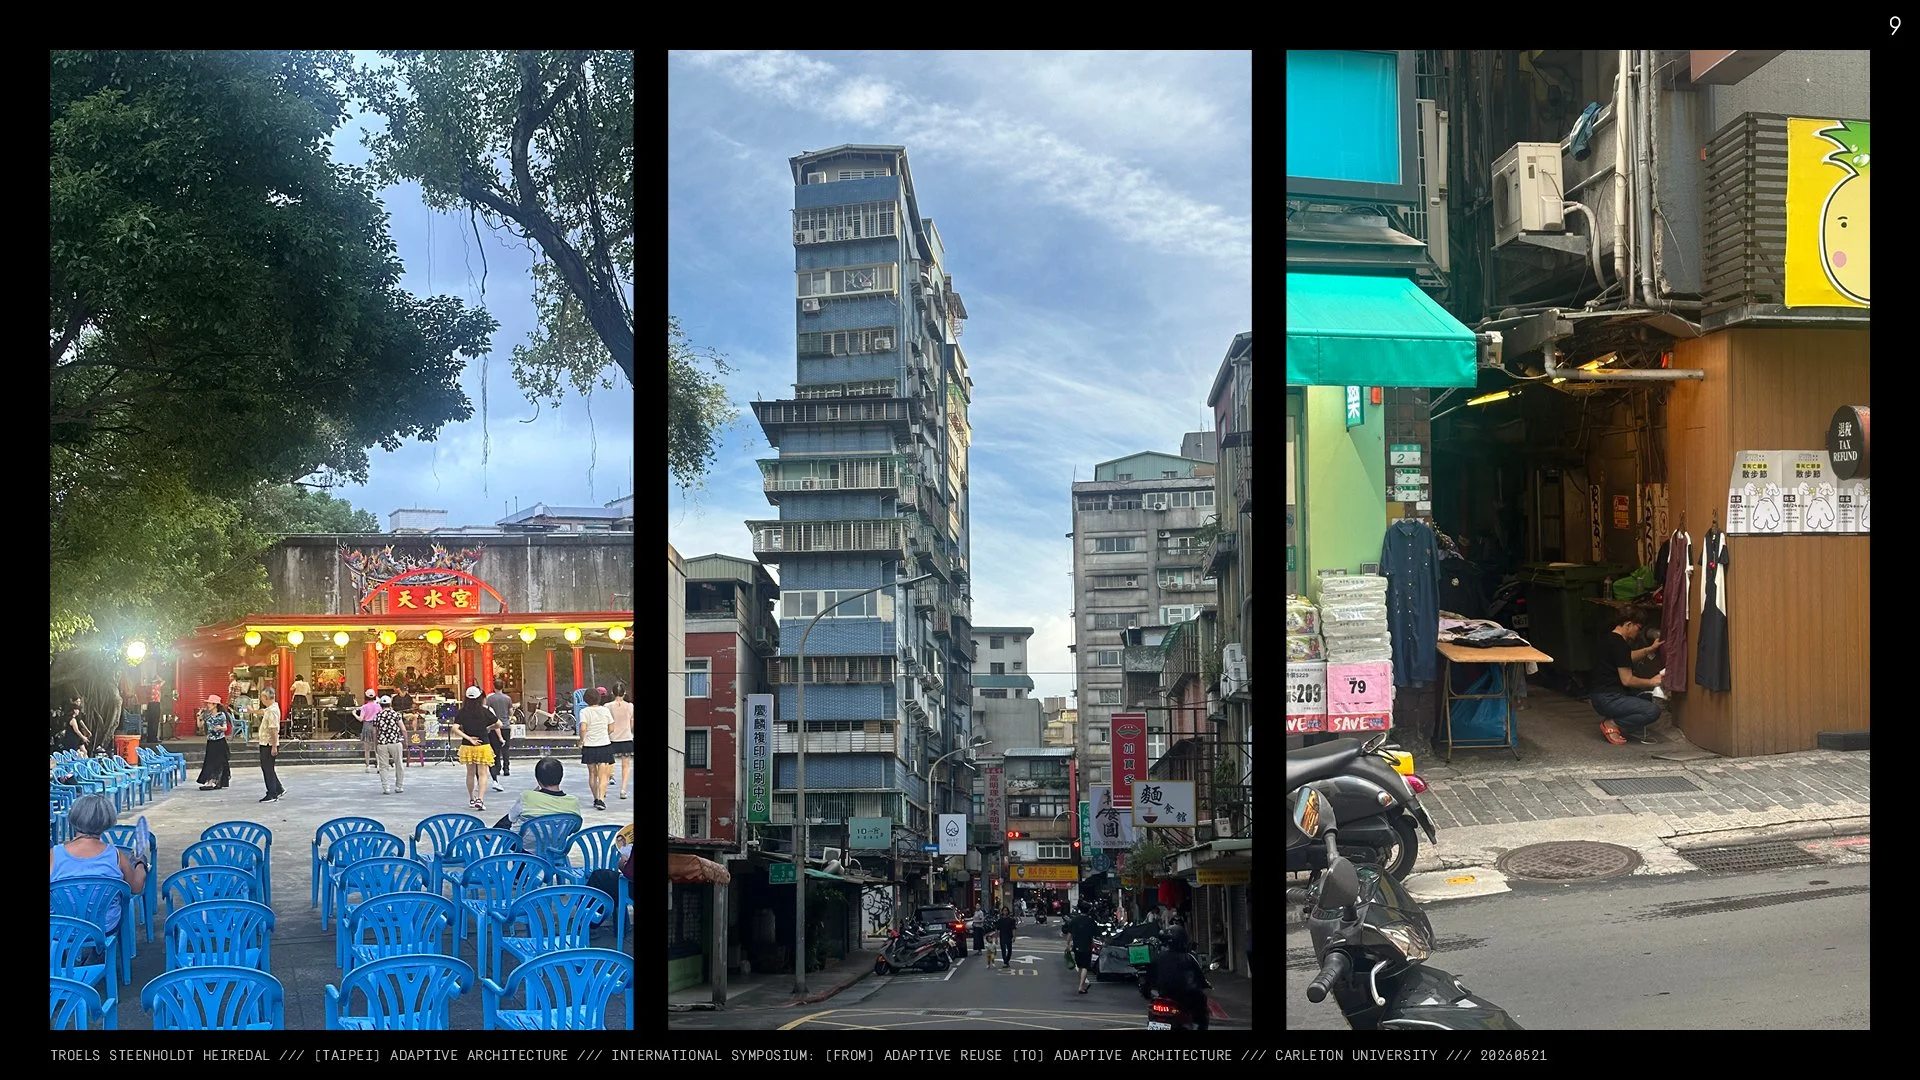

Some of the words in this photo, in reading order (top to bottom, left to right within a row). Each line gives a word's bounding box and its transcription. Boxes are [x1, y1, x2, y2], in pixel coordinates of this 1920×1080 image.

[1839, 440, 1851, 449] TAX
[1396, 453, 1405, 464] 2
[1833, 451, 1857, 462] REFUND
[1742, 470, 1767, 478] 散步節
[1796, 470, 1821, 478] 散步節
[397, 588, 472, 609] 天水宮
[1349, 680, 1366, 694] 79
[1333, 716, 1370, 731] SAVE
[1140, 784, 1187, 823] 麵食館
[996, 968, 1039, 976] 30
